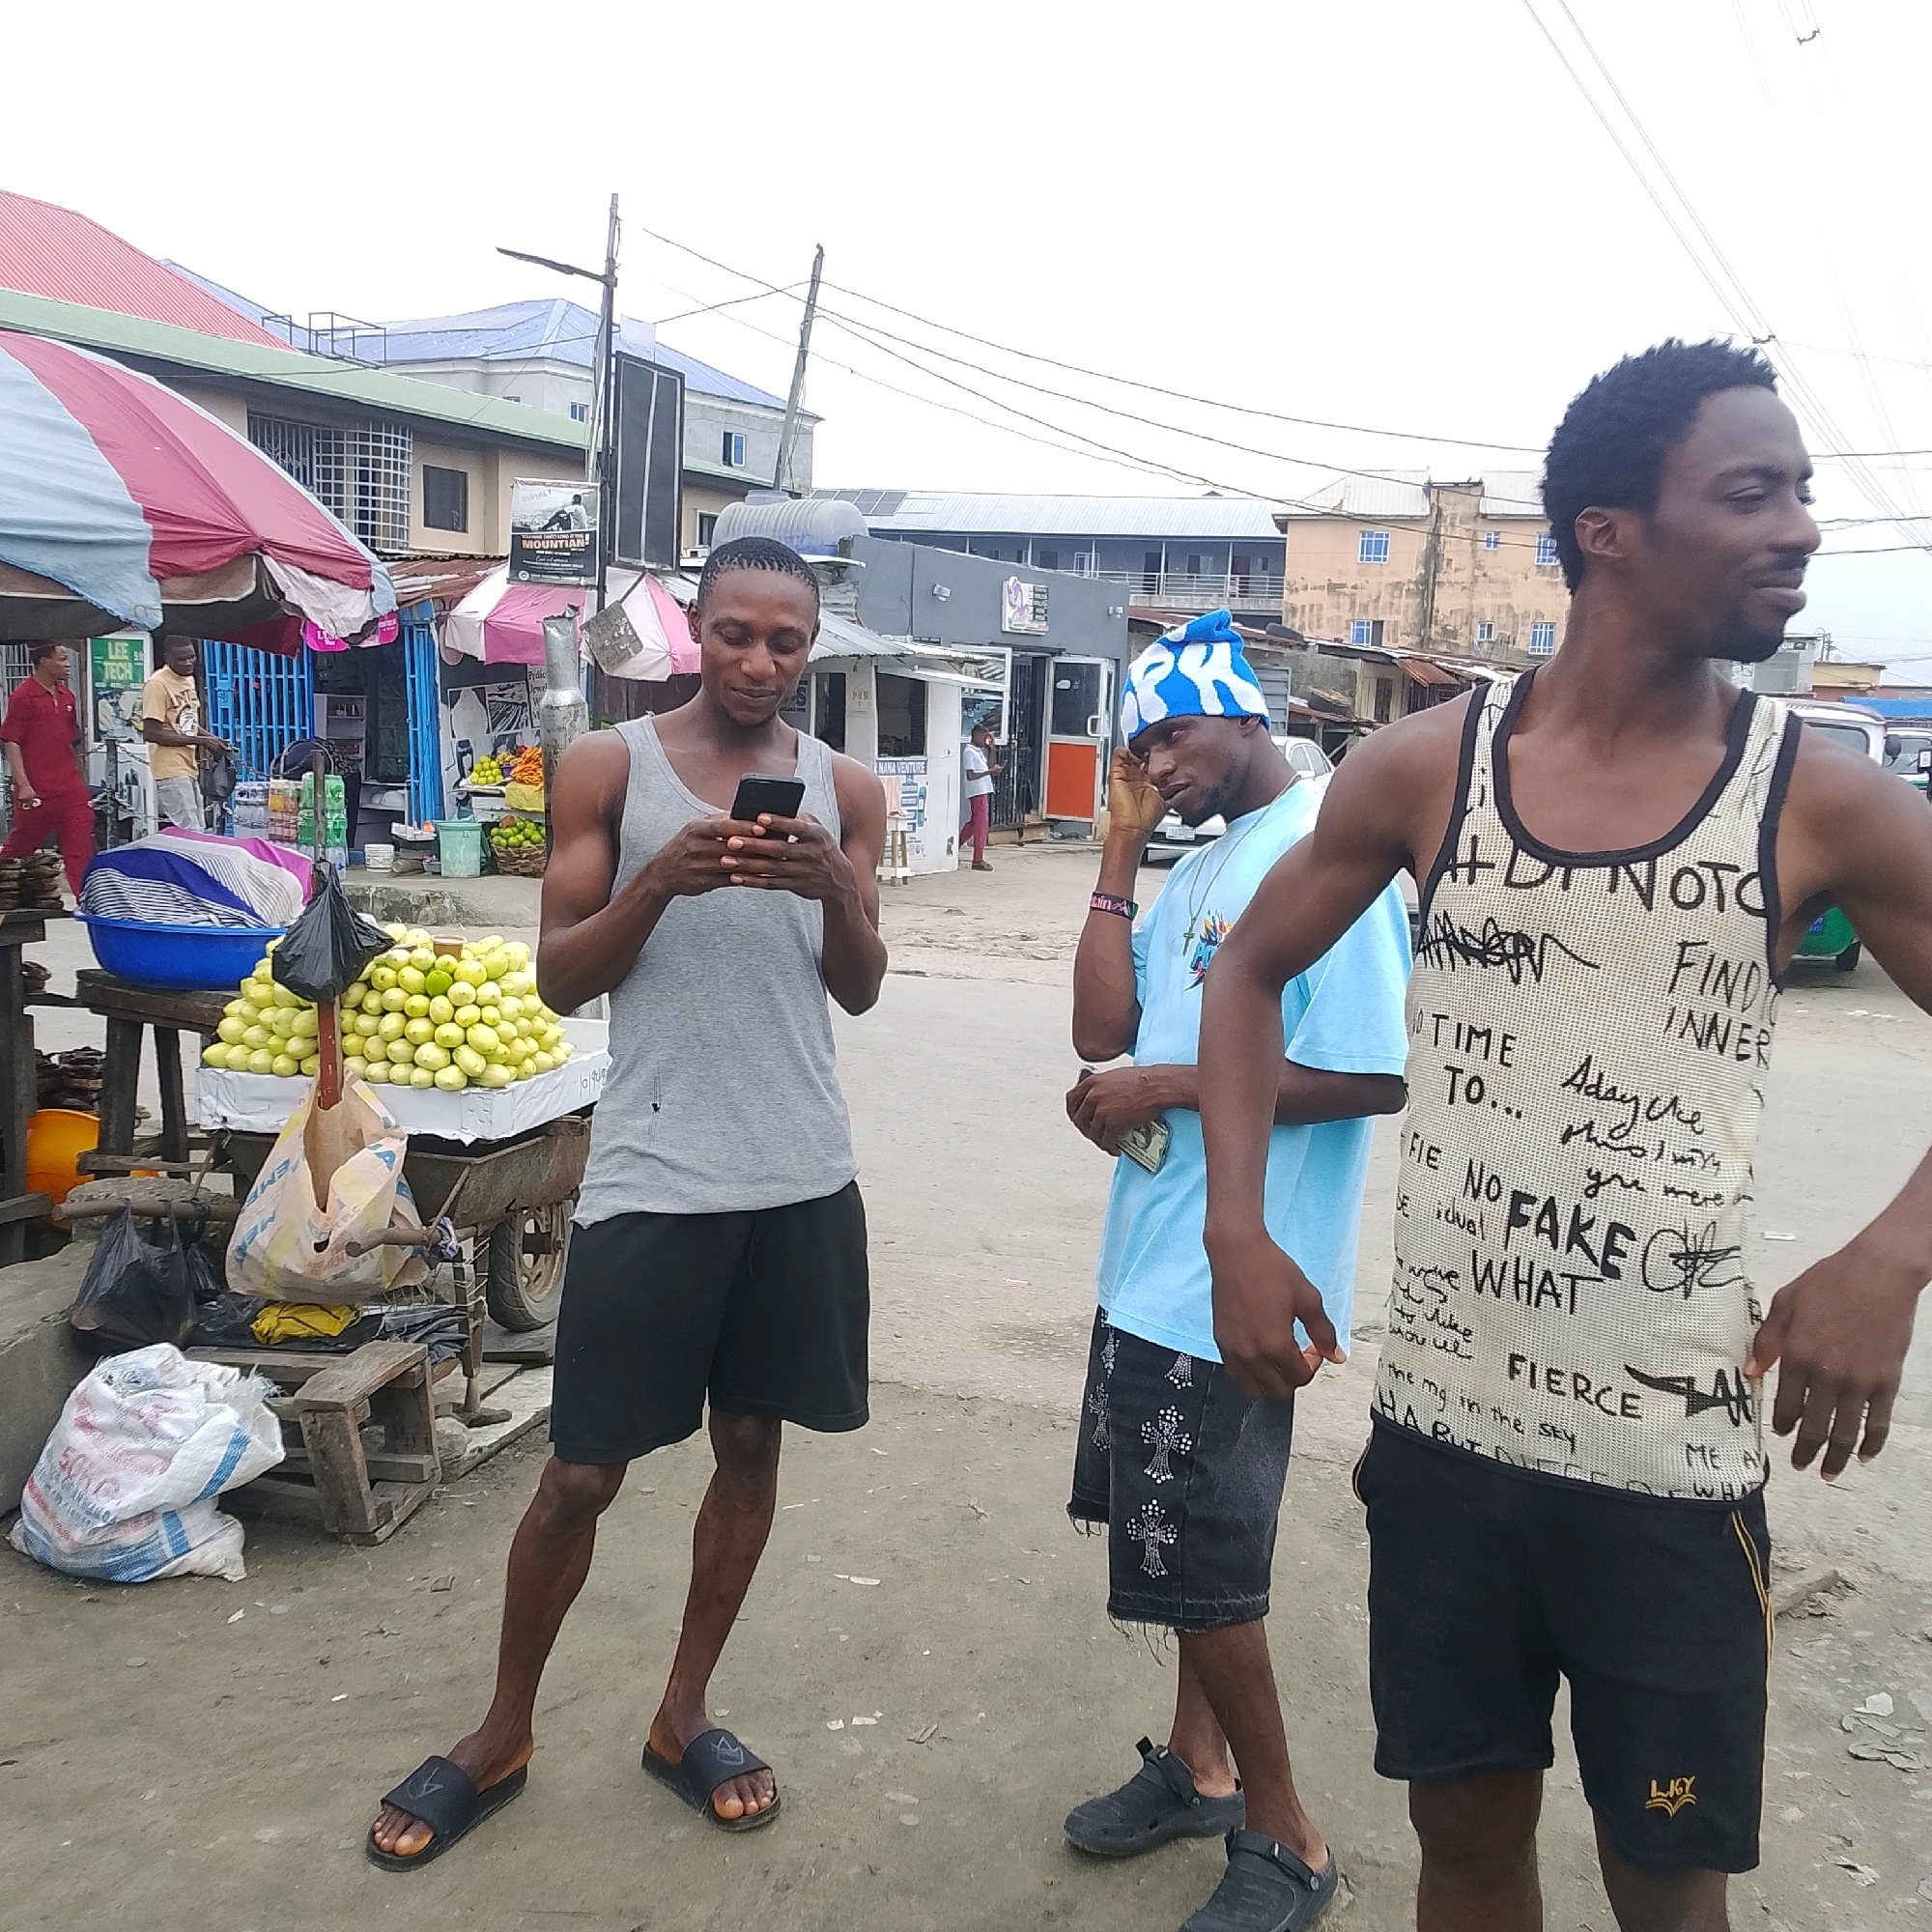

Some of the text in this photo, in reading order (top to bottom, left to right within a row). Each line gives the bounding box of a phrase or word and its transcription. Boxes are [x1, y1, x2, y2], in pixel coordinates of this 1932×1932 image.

[103, 662, 132, 681] TECH
[108, 641, 128, 660] LEE
[878, 761, 925, 774] NANA VENTURE
[1433, 1013, 1517, 1068] TIME
[1663, 1005, 1772, 1070] INNER
[1504, 1189, 1637, 1280] FAKE
[1471, 1248, 1605, 1315] WHAT
[1508, 1352, 1642, 1419] FIERCE
